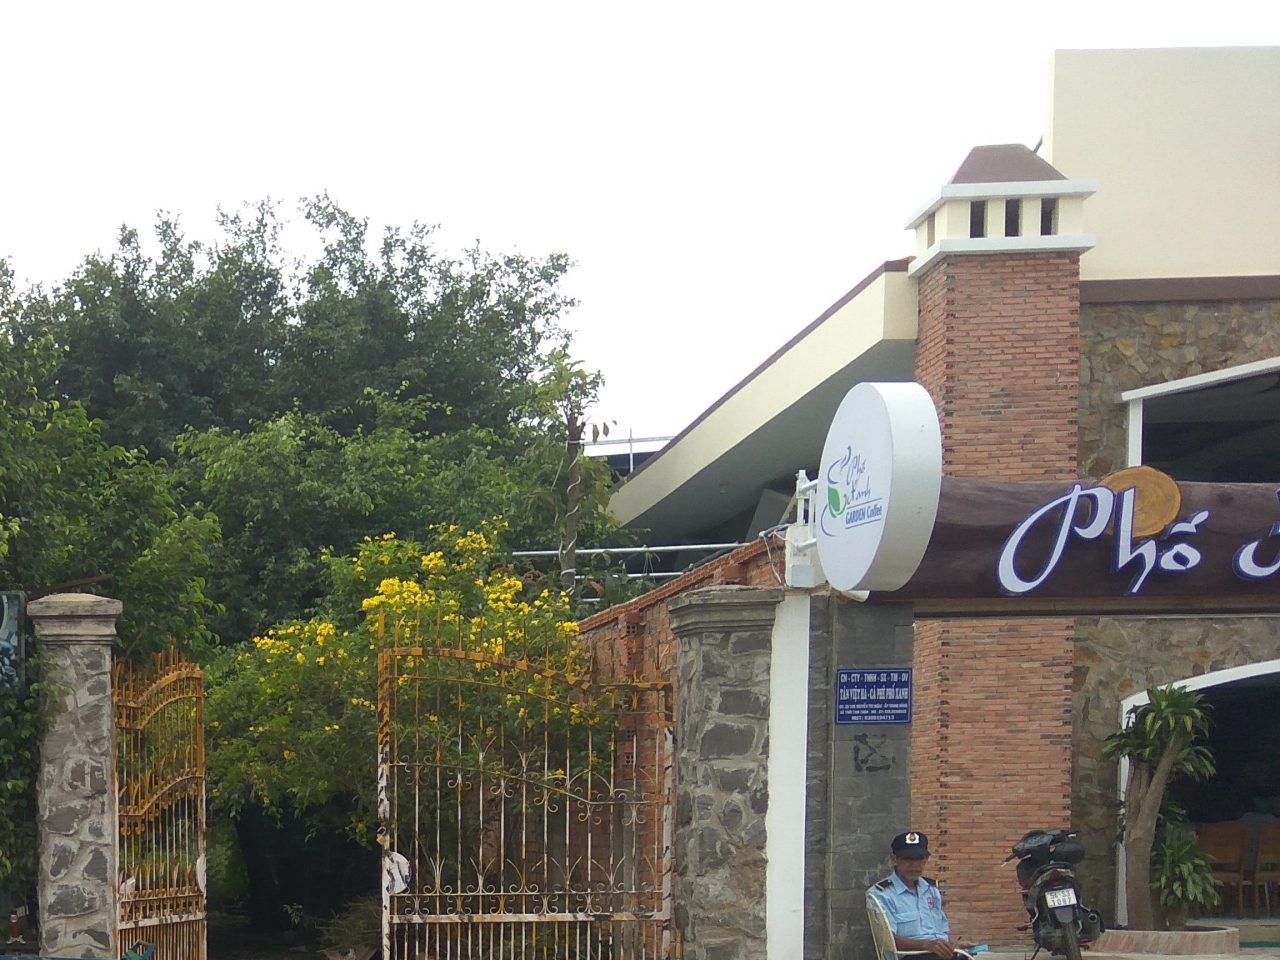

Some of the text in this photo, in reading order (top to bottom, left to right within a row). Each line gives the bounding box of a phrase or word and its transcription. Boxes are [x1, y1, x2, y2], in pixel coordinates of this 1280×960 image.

[847, 454, 867, 486] Phố
[845, 507, 866, 525] GARDEN
[997, 484, 1210, 594] Phố
